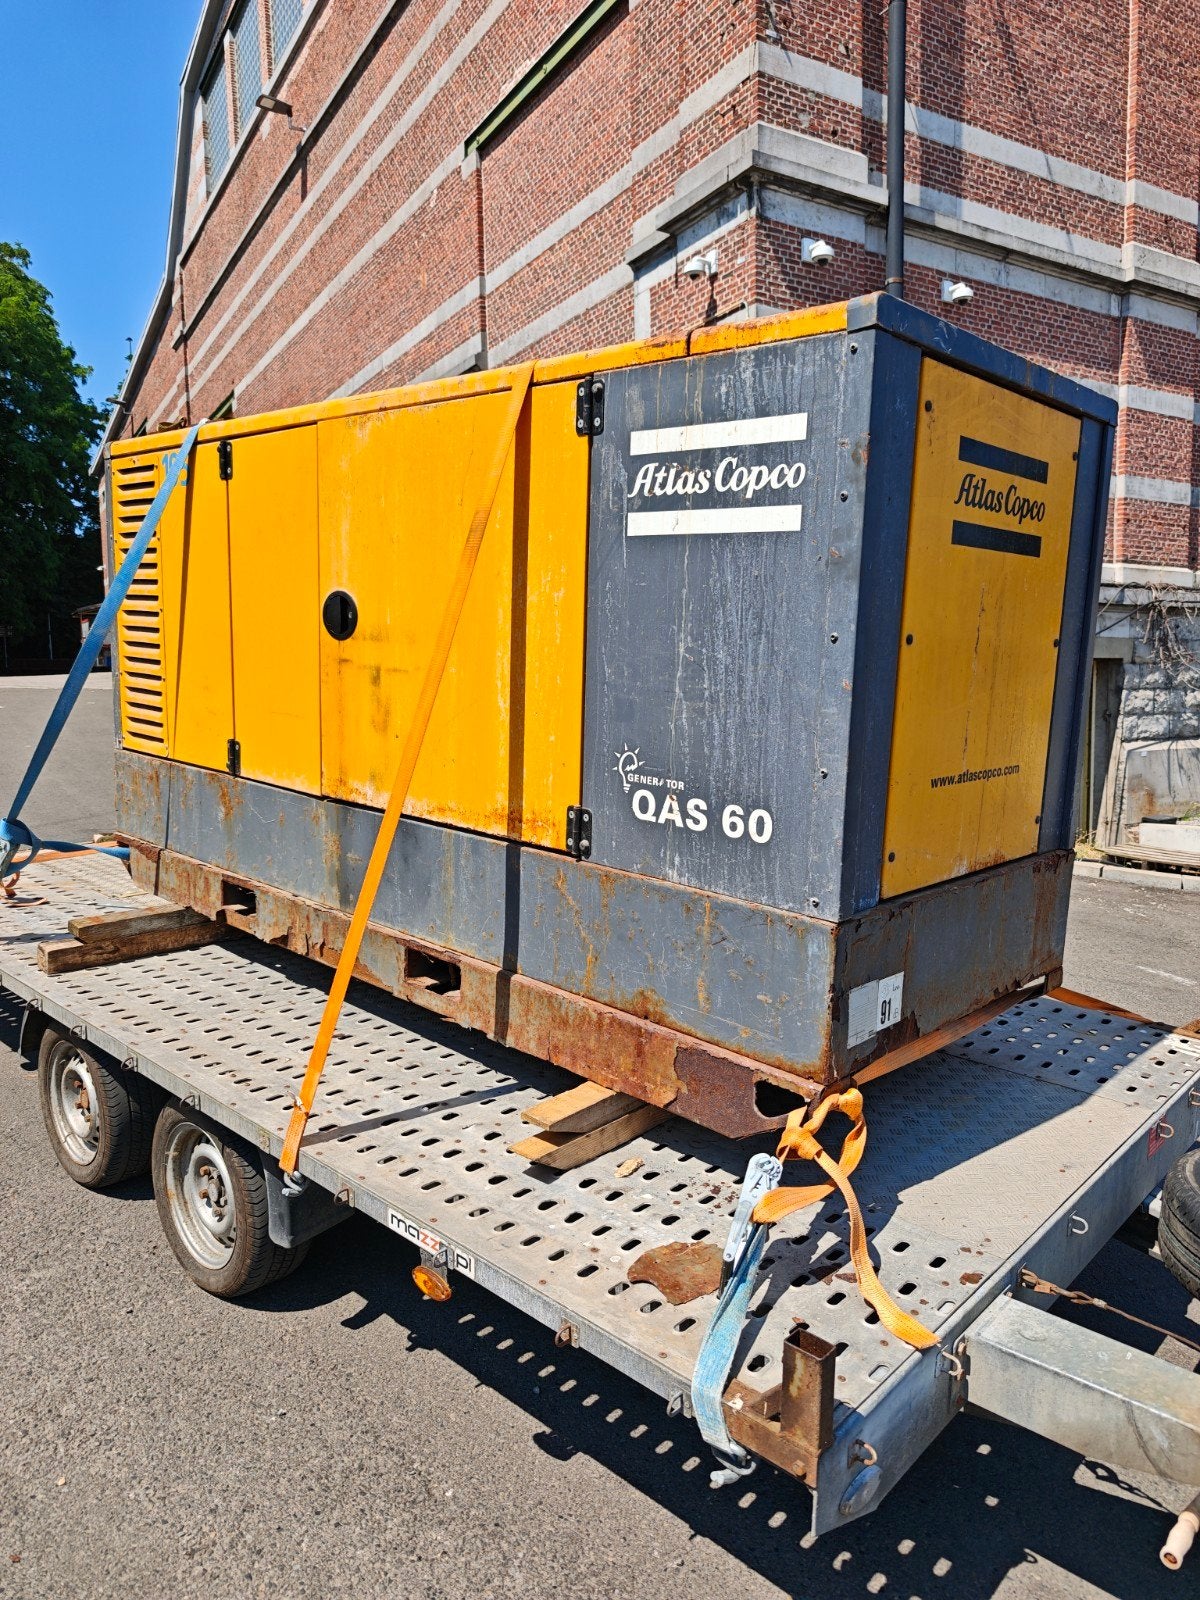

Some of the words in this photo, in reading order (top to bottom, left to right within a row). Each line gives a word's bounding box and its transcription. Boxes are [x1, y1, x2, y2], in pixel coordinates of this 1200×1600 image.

[628, 463, 711, 498] Atlas
[715, 456, 806, 498] Copco
[954, 473, 1003, 513] Atlas
[1005, 484, 1045, 524] Copco
[930, 764, 1020, 788] www.atlascopco.com
[632, 789, 708, 832] QAS
[722, 804, 773, 844] 60
[880, 998, 891, 1025] 91
